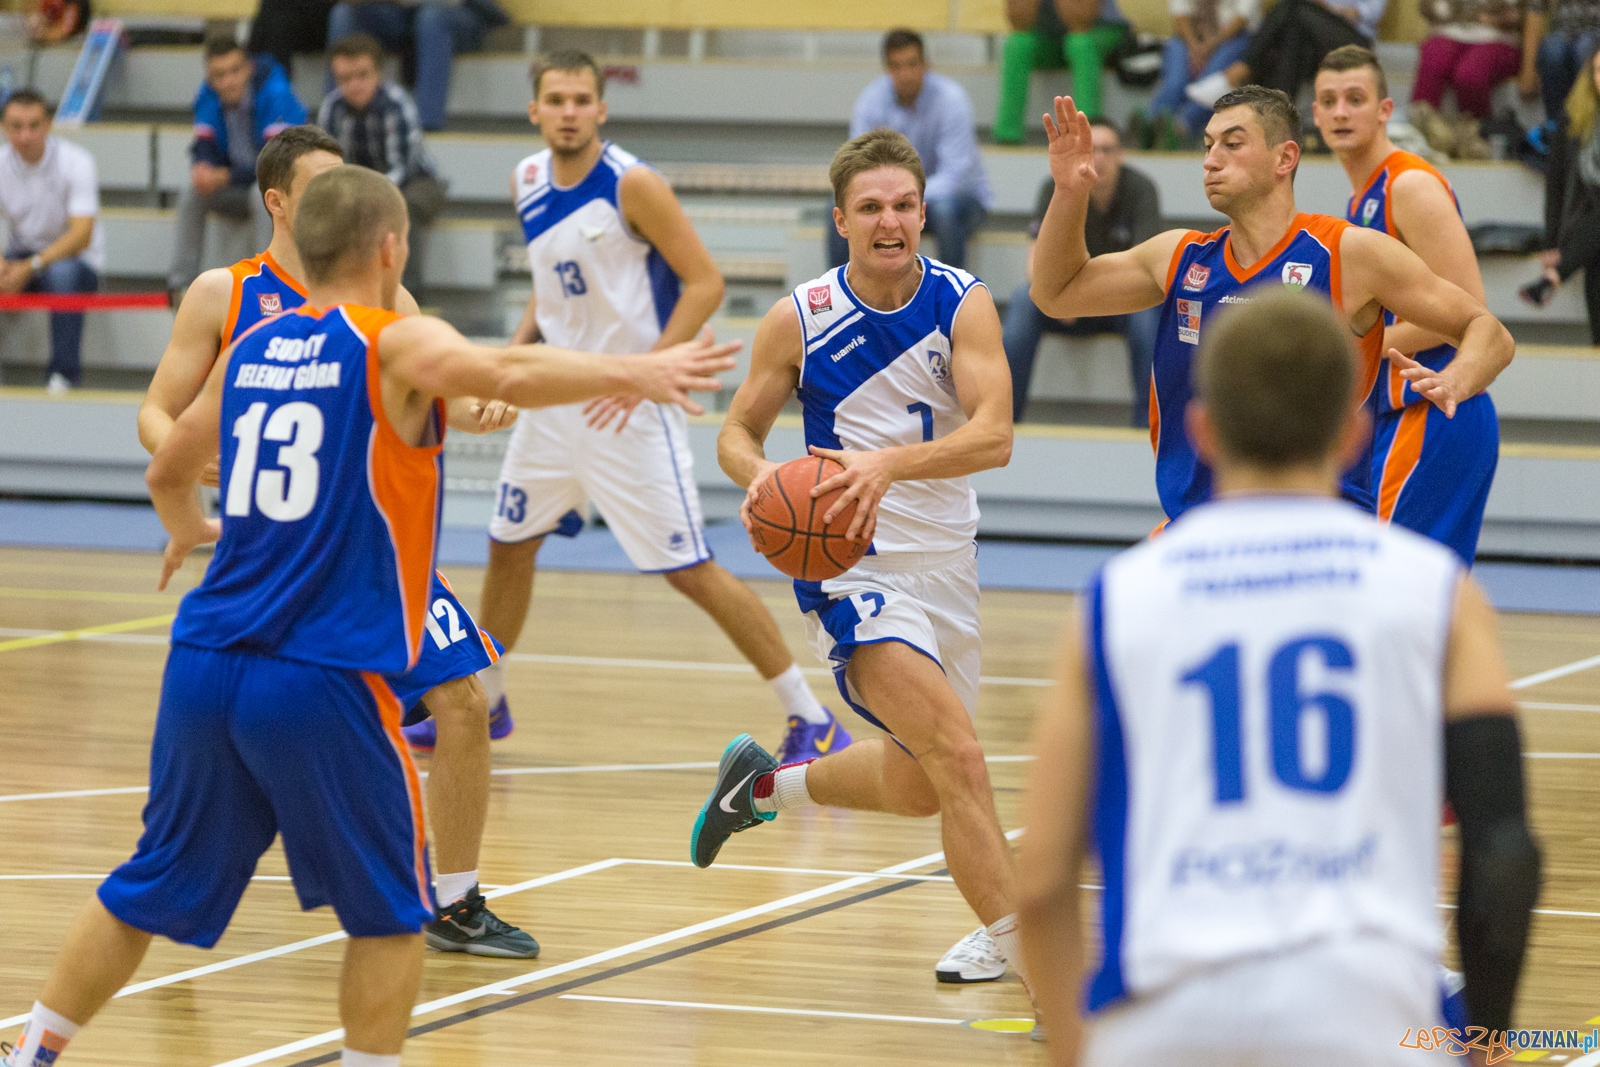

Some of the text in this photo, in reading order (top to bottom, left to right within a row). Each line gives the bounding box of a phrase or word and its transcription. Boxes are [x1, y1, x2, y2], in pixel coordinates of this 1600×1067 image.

[553, 260, 588, 298] 13
[830, 338, 859, 363] luanvi
[293, 359, 341, 391] GÓRA
[906, 401, 934, 443] 7
[225, 401, 325, 522] 13
[497, 482, 528, 524] 13
[424, 597, 469, 651] 12
[1179, 629, 1359, 807] 16
